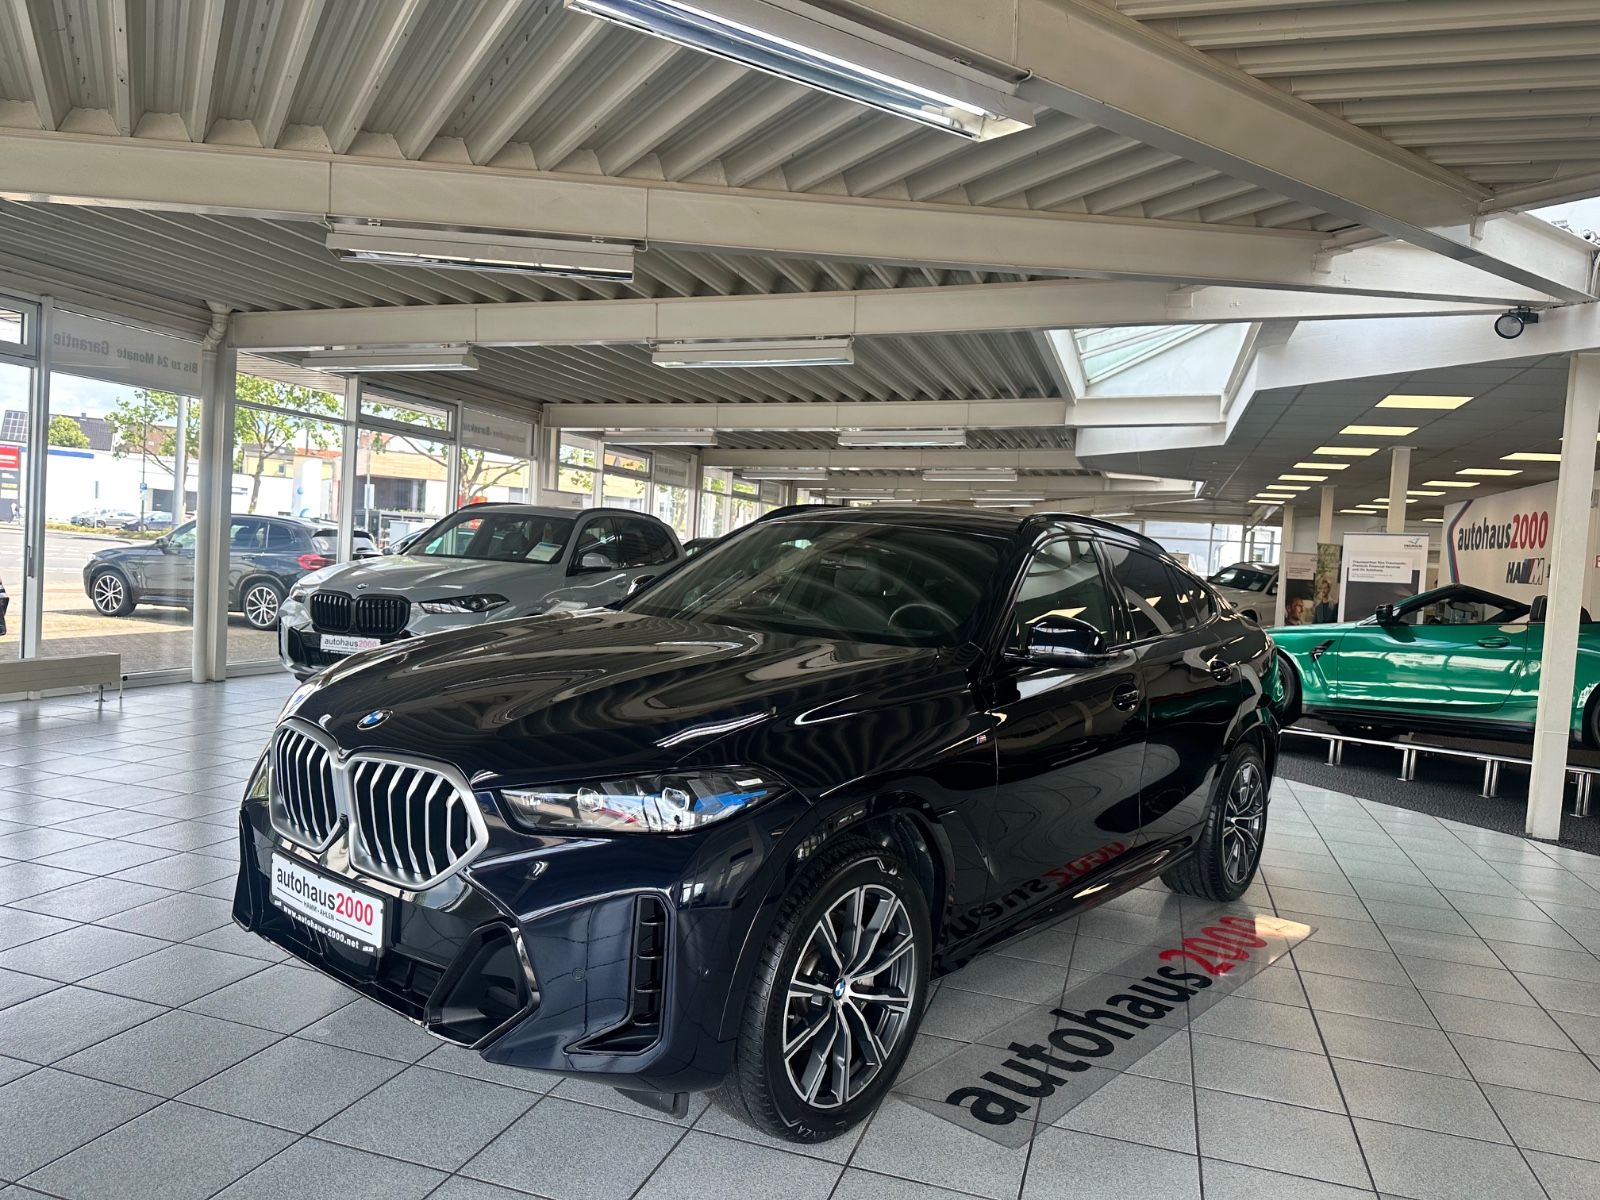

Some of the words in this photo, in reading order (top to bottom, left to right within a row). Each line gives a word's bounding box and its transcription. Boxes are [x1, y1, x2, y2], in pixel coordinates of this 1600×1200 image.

[1457, 511, 1549, 551] autohaus2000
[324, 638, 377, 649] autohaus2000
[276, 867, 374, 927] autohaus2000
[283, 906, 360, 948] www.autohaus-2000.net
[945, 915, 1268, 1126] autohaus2000
